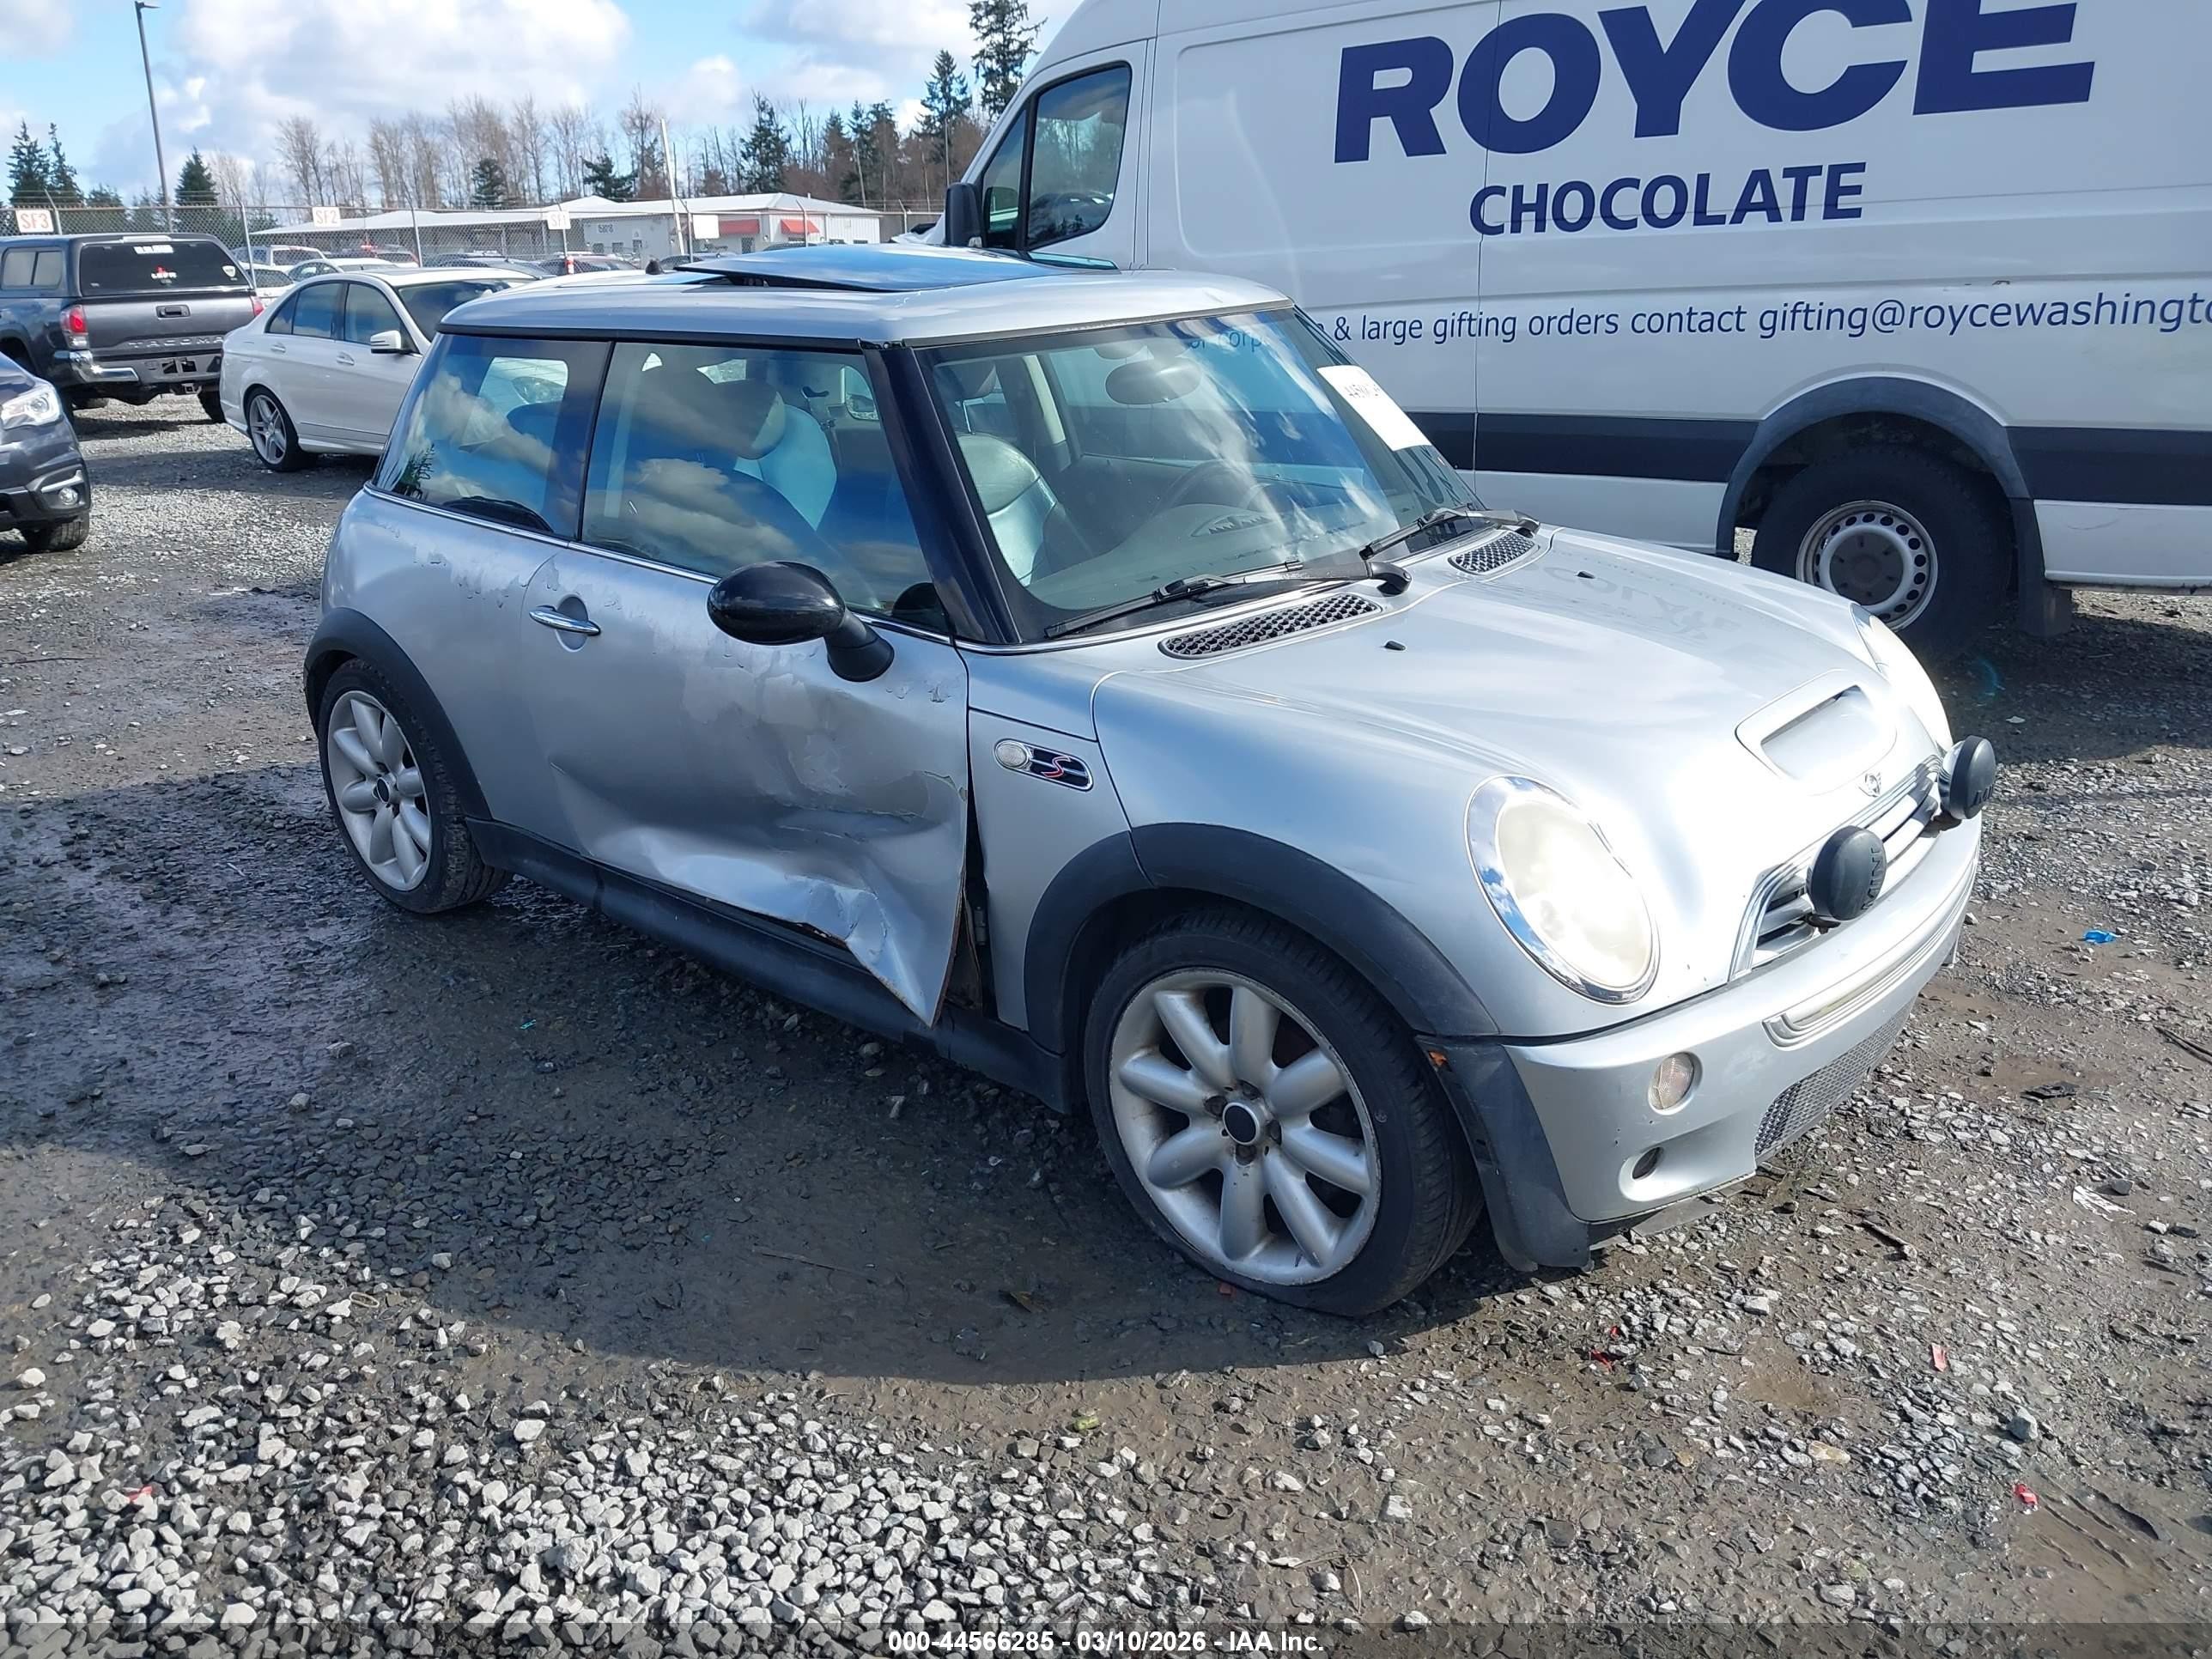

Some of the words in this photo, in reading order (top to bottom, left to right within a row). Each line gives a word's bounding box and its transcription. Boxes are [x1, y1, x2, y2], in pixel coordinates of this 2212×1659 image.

[1334, 0, 2095, 164] ROYCE
[1469, 161, 1867, 235] CHOCOLATE
[20, 213, 49, 229] SF3
[315, 210, 337, 224] SF2
[1334, 316, 1352, 342] &
[1361, 314, 1424, 345] large
[1432, 311, 1517, 345] gifting
[1528, 307, 1620, 336] orders
[1630, 305, 1748, 334] contact
[1758, 292, 2212, 339] gifting@roycewashingt
[128, 336, 224, 349] TACOMA
